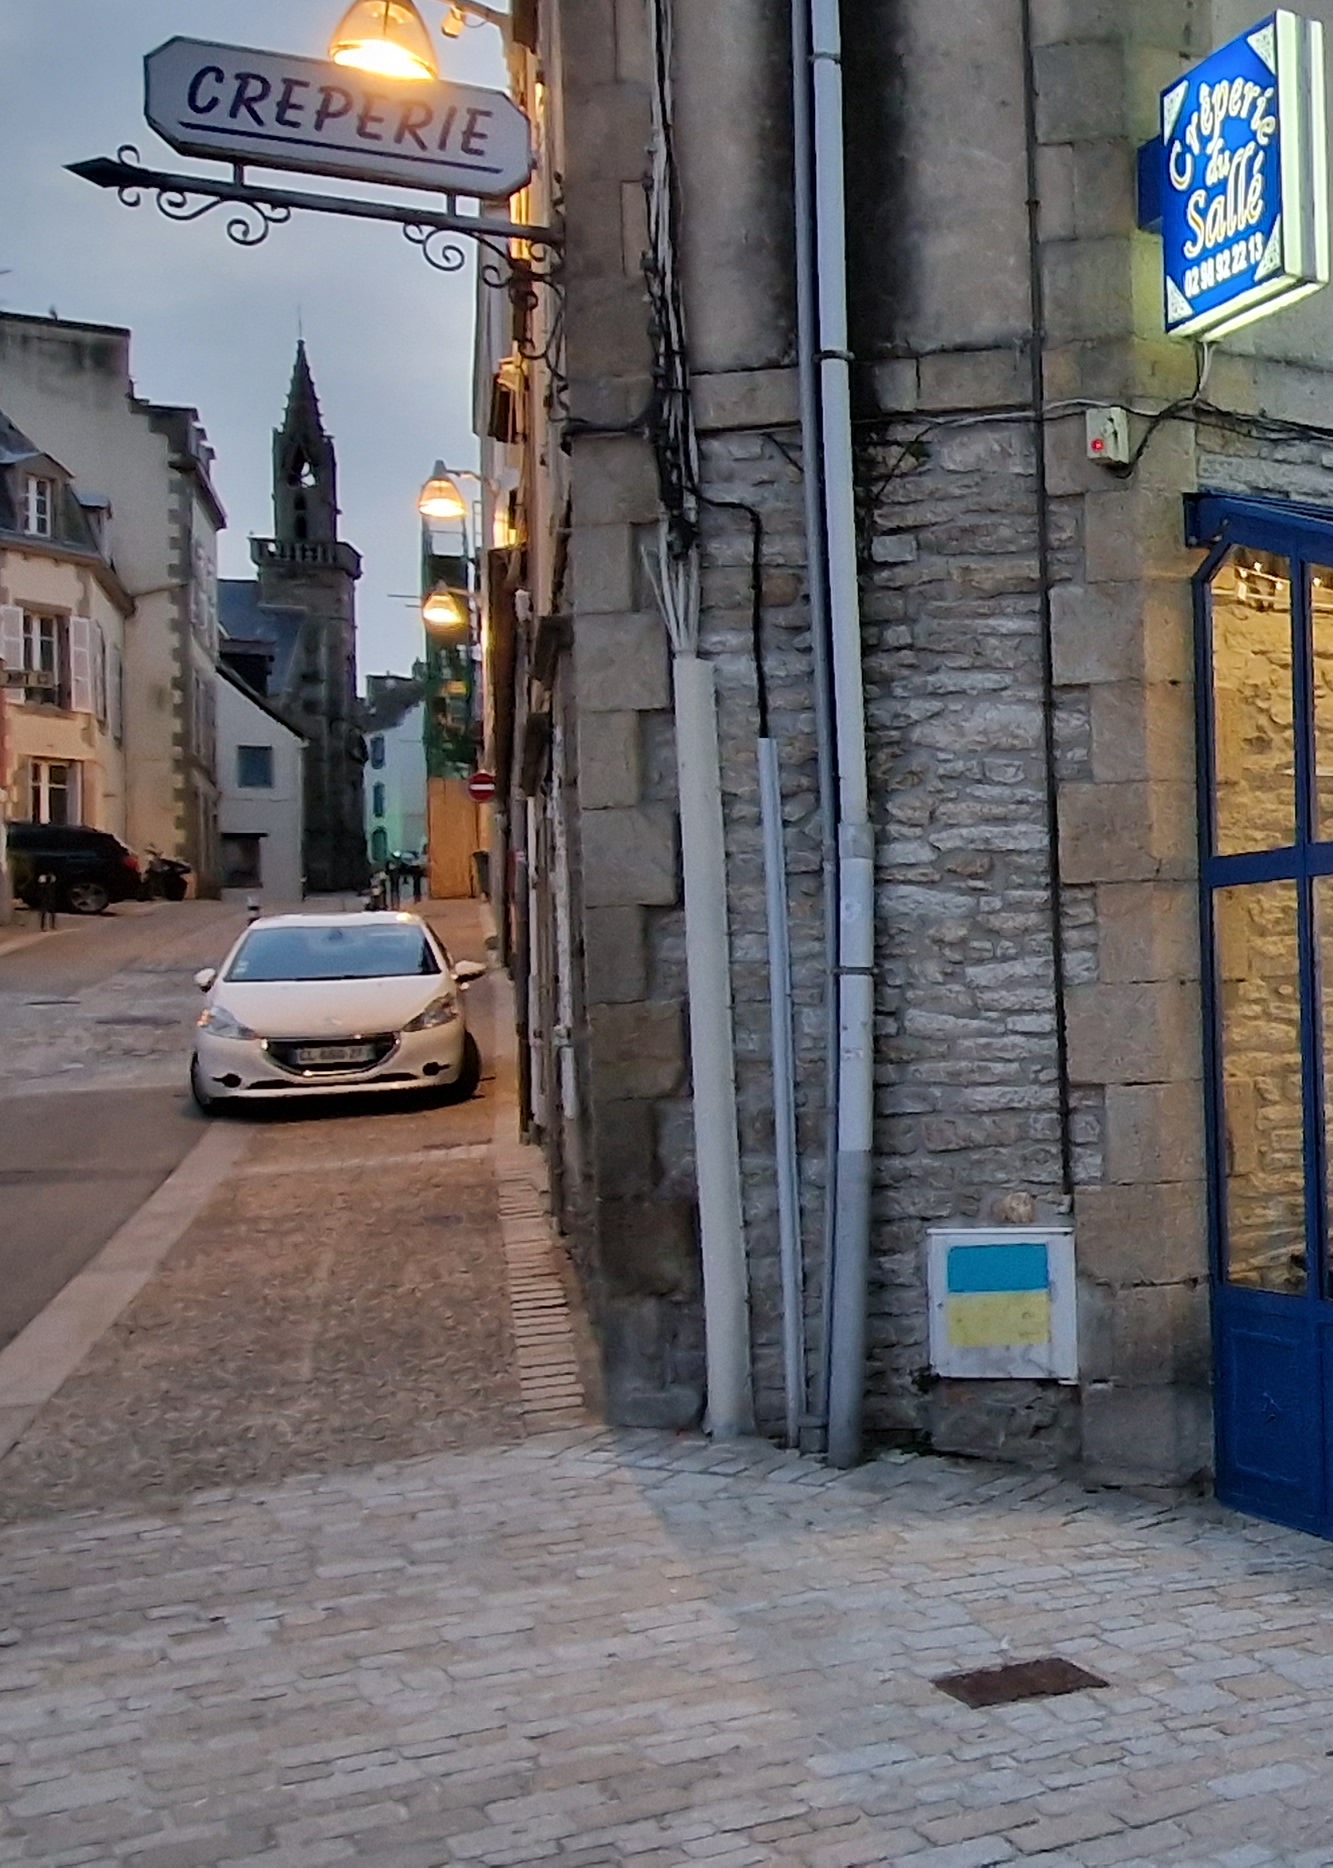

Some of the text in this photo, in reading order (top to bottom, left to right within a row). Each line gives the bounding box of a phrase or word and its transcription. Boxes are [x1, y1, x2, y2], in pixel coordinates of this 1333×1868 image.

[188, 65, 493, 157] CREPERIE
[1169, 76, 1276, 191] Crêperie
[1184, 141, 1266, 259] Sallé
[1206, 138, 1231, 187] du
[1184, 265, 1200, 298] 02
[1216, 249, 1231, 282] 92
[1232, 240, 1247, 274] 22
[1248, 231, 1263, 265] 13
